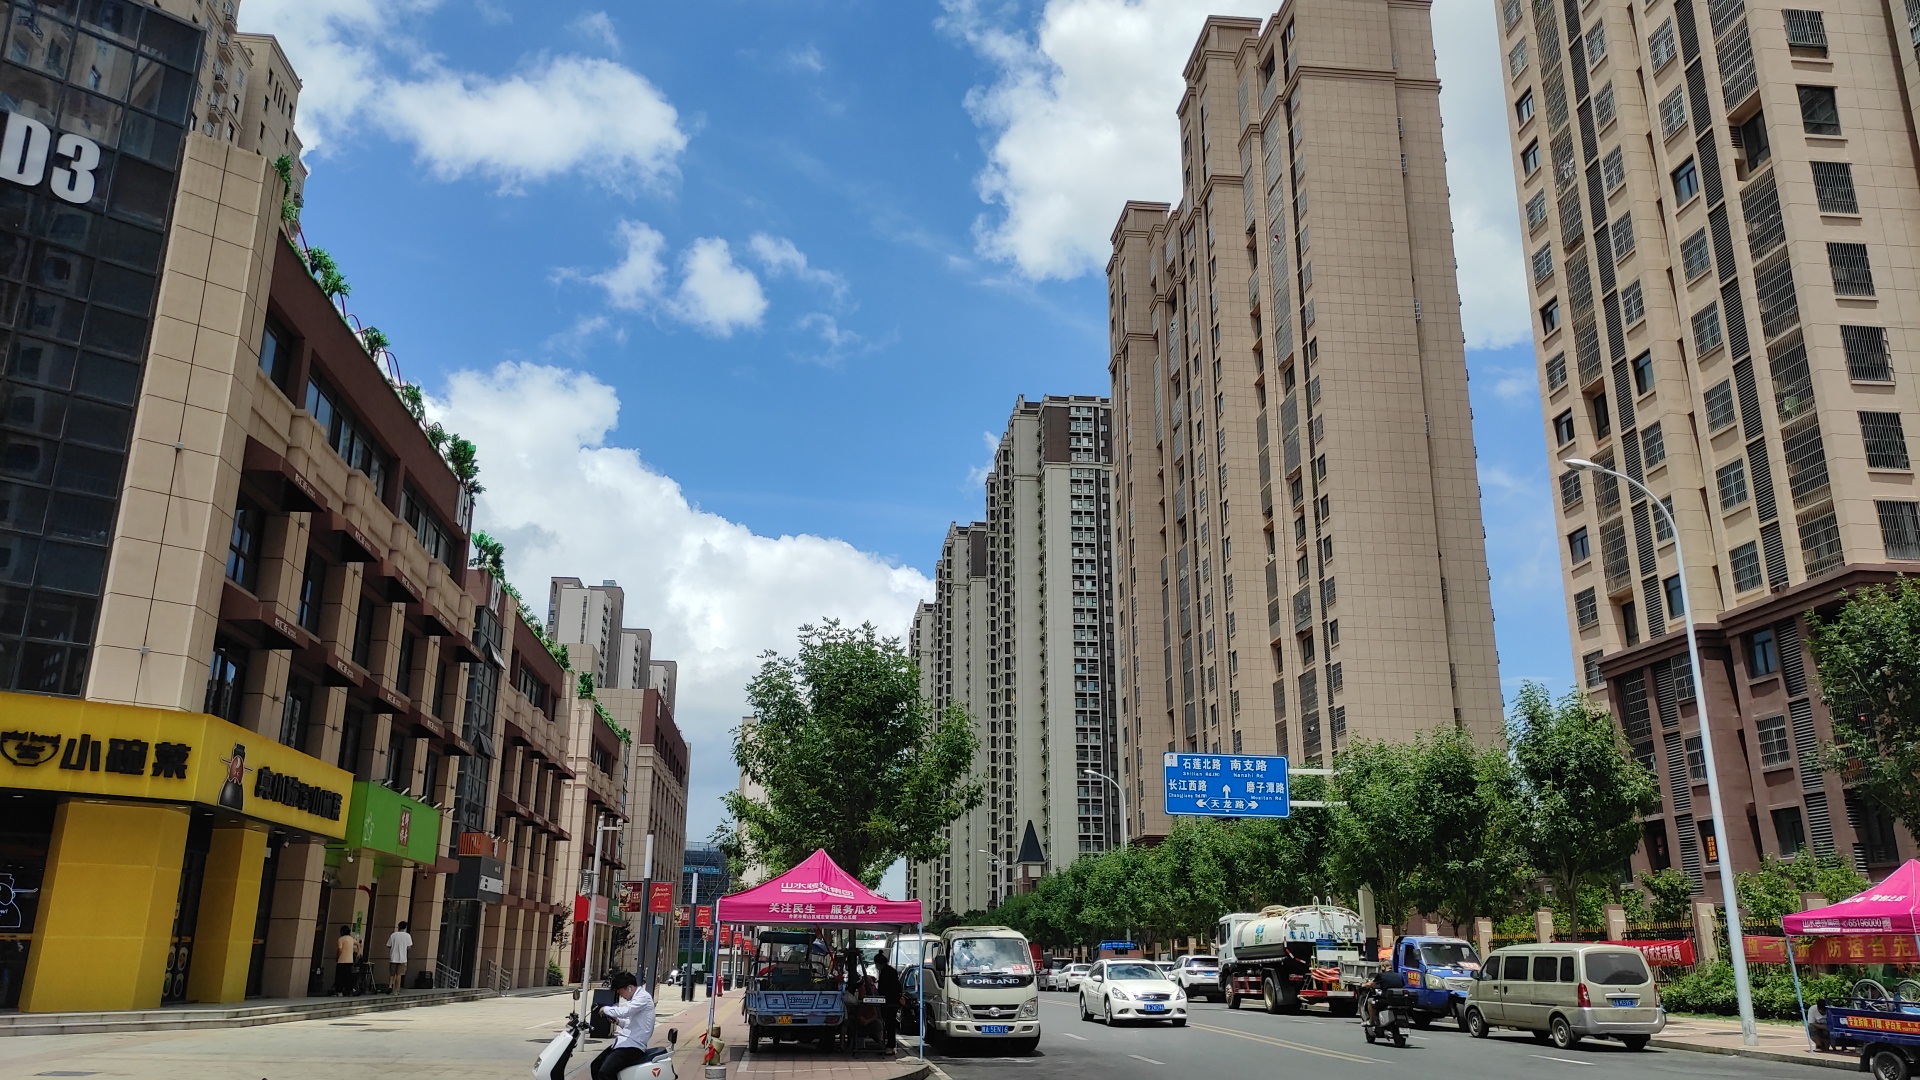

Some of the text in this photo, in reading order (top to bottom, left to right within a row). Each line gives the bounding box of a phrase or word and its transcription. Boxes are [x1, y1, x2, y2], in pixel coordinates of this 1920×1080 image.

[0, 111, 101, 204] D3
[59, 734, 192, 779] 小碗菜
[1182, 758, 1222, 771] 石莲北路
[1230, 759, 1268, 772] 南支路
[1168, 779, 1285, 794] 长江西路 磨子潭路
[1210, 800, 1245, 810] 天龙路
[768, 903, 878, 915] 关注民生 服务瓜农
[1826, 935, 1912, 958] 防控当先
